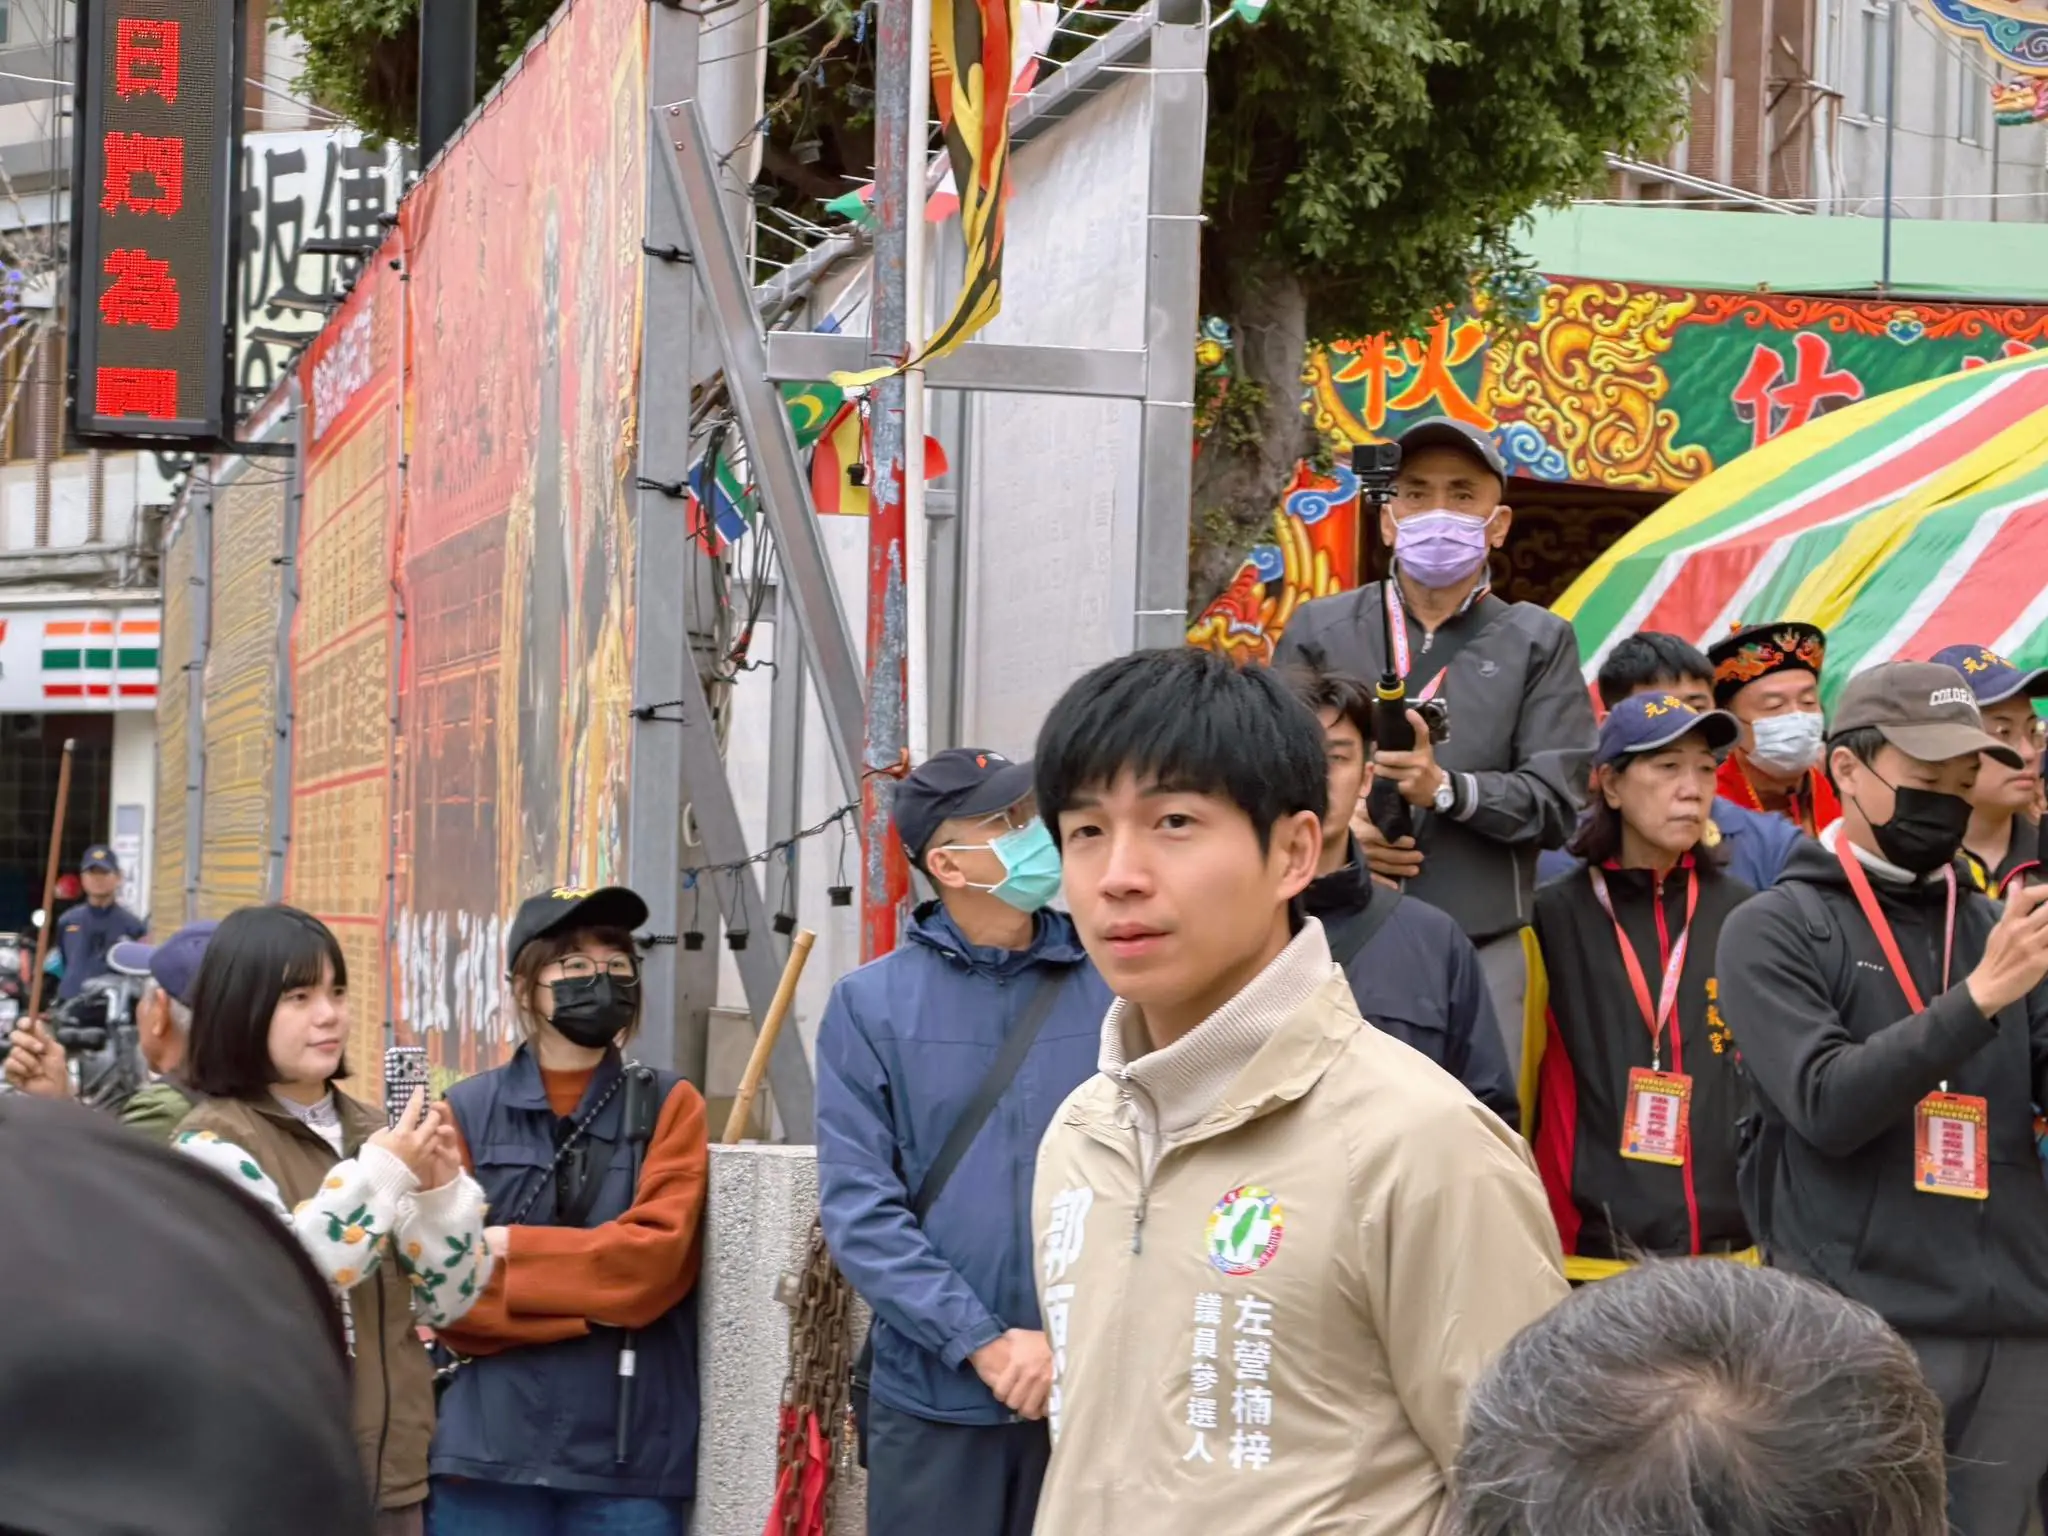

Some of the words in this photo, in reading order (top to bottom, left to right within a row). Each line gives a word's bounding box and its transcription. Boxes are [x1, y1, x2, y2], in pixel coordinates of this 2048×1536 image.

[1331, 304, 1498, 431] 秋
[1182, 1292, 1223, 1464] 議員參選人
[1228, 1294, 1274, 1471] 左營楠梓
